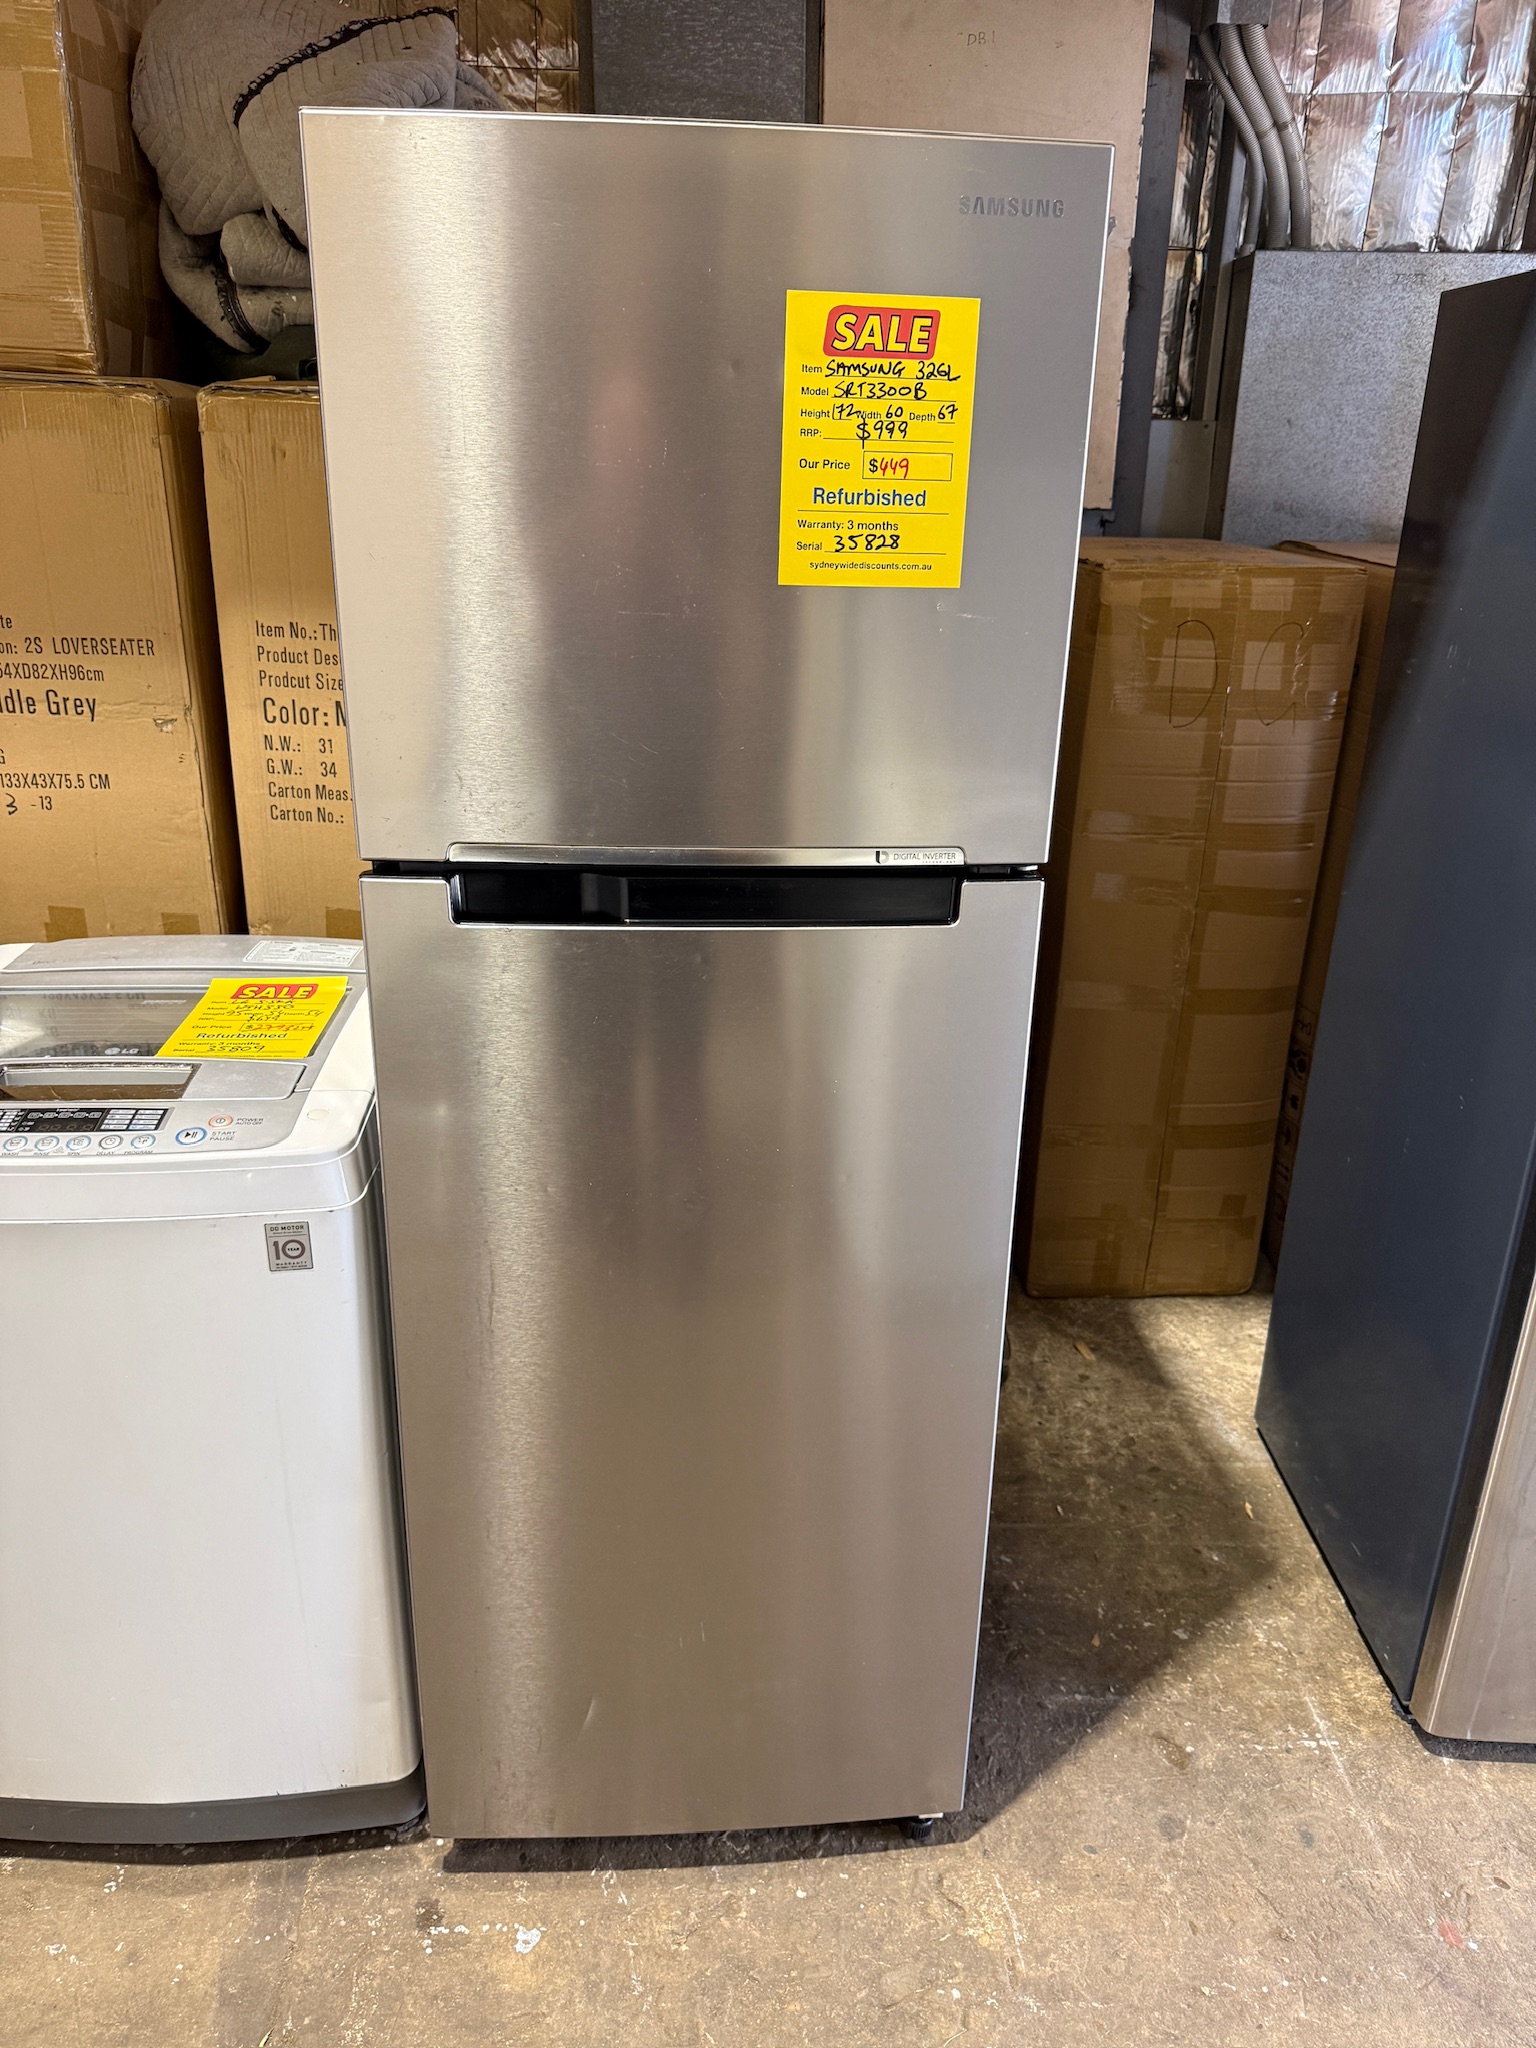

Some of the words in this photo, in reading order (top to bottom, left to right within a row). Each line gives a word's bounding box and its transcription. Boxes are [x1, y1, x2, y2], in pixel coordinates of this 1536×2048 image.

[959, 195, 1064, 218] SAMSUNG
[830, 312, 933, 354] SALE
[802, 364, 822, 374] Item
[825, 360, 906, 378] SAMSUNG
[801, 387, 828, 396] Model
[832, 381, 927, 400] SRT3300B
[800, 408, 830, 420] Height
[886, 404, 904, 419] 60
[909, 412, 936, 422] Depth
[937, 404, 958, 420] 67
[800, 428, 822, 438] RRP:
[856, 418, 908, 450] $999
[799, 458, 819, 469] Our
[823, 459, 850, 470] Price
[868, 457, 909, 479] $449
[814, 487, 926, 506] Refurbished
[797, 520, 844, 530] Warranty:
[847, 520, 854, 530] 3
[858, 521, 898, 531] months
[796, 541, 822, 551] Serial
[834, 534, 900, 552] 35828
[810, 561, 932, 570] sydneywidediscounts.com.au
[256, 620, 284, 638] Item
[25, 637, 43, 654] 2S
[52, 637, 154, 656] LOVERSEATER
[257, 645, 308, 664] Product
[314, 648, 339, 666] Des
[259, 670, 310, 689] Prodcut
[316, 673, 343, 691] Size
[46, 689, 96, 722] Grey
[263, 697, 329, 726] Color:
[264, 735, 301, 752] N.W.:
[318, 738, 333, 754] 31
[266, 758, 302, 776] G.W.:
[320, 761, 337, 778] 34
[89, 773, 111, 789] CM
[268, 782, 311, 799] Carton
[315, 784, 353, 801] Meas.
[270, 804, 312, 822] Carton
[317, 807, 344, 824] No.:
[893, 853, 920, 861] DIGITAL
[238, 986, 312, 999] SALE
[273, 1239, 306, 1260] 10
